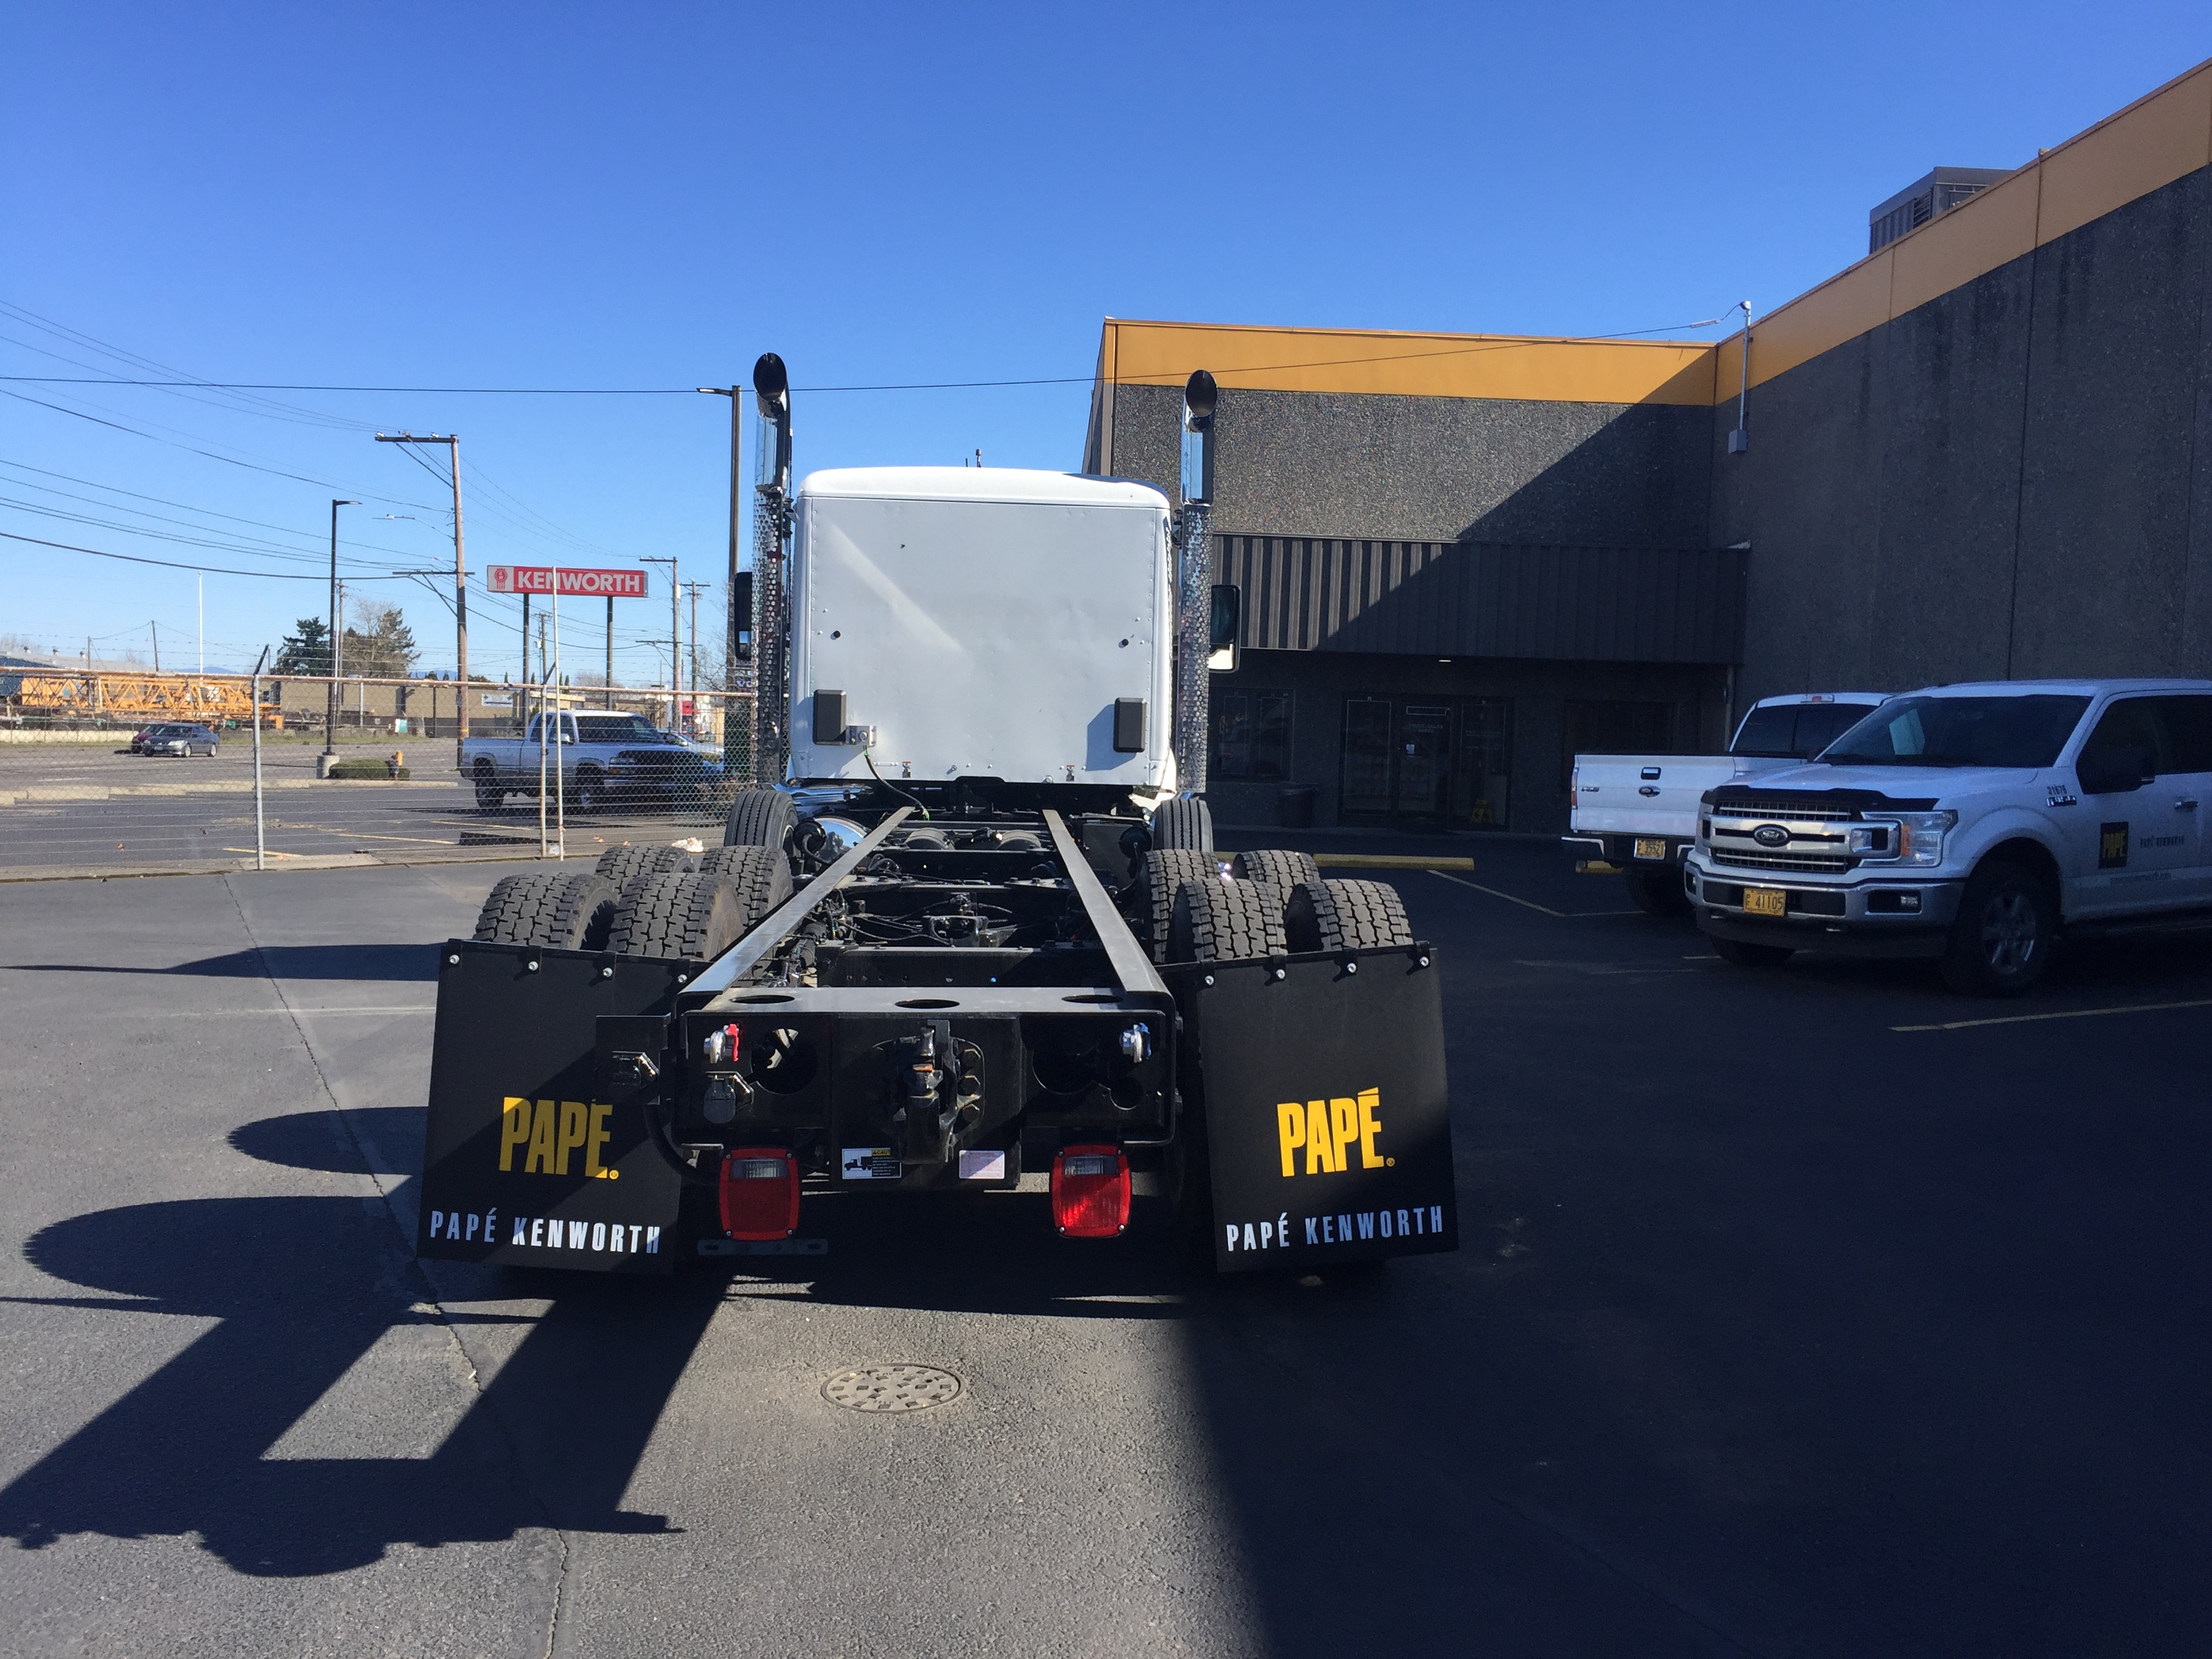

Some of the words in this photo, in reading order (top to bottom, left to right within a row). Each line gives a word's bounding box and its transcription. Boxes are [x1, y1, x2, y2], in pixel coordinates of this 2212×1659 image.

[518, 571, 640, 592] KENWORTH
[1755, 895, 1783, 909] 41105
[430, 1208, 497, 1243] PAPÉ
[512, 1217, 661, 1254] KENWORTH
[1226, 1212, 1290, 1252] PAPÉ
[1305, 1205, 1443, 1245] KENWORTH
